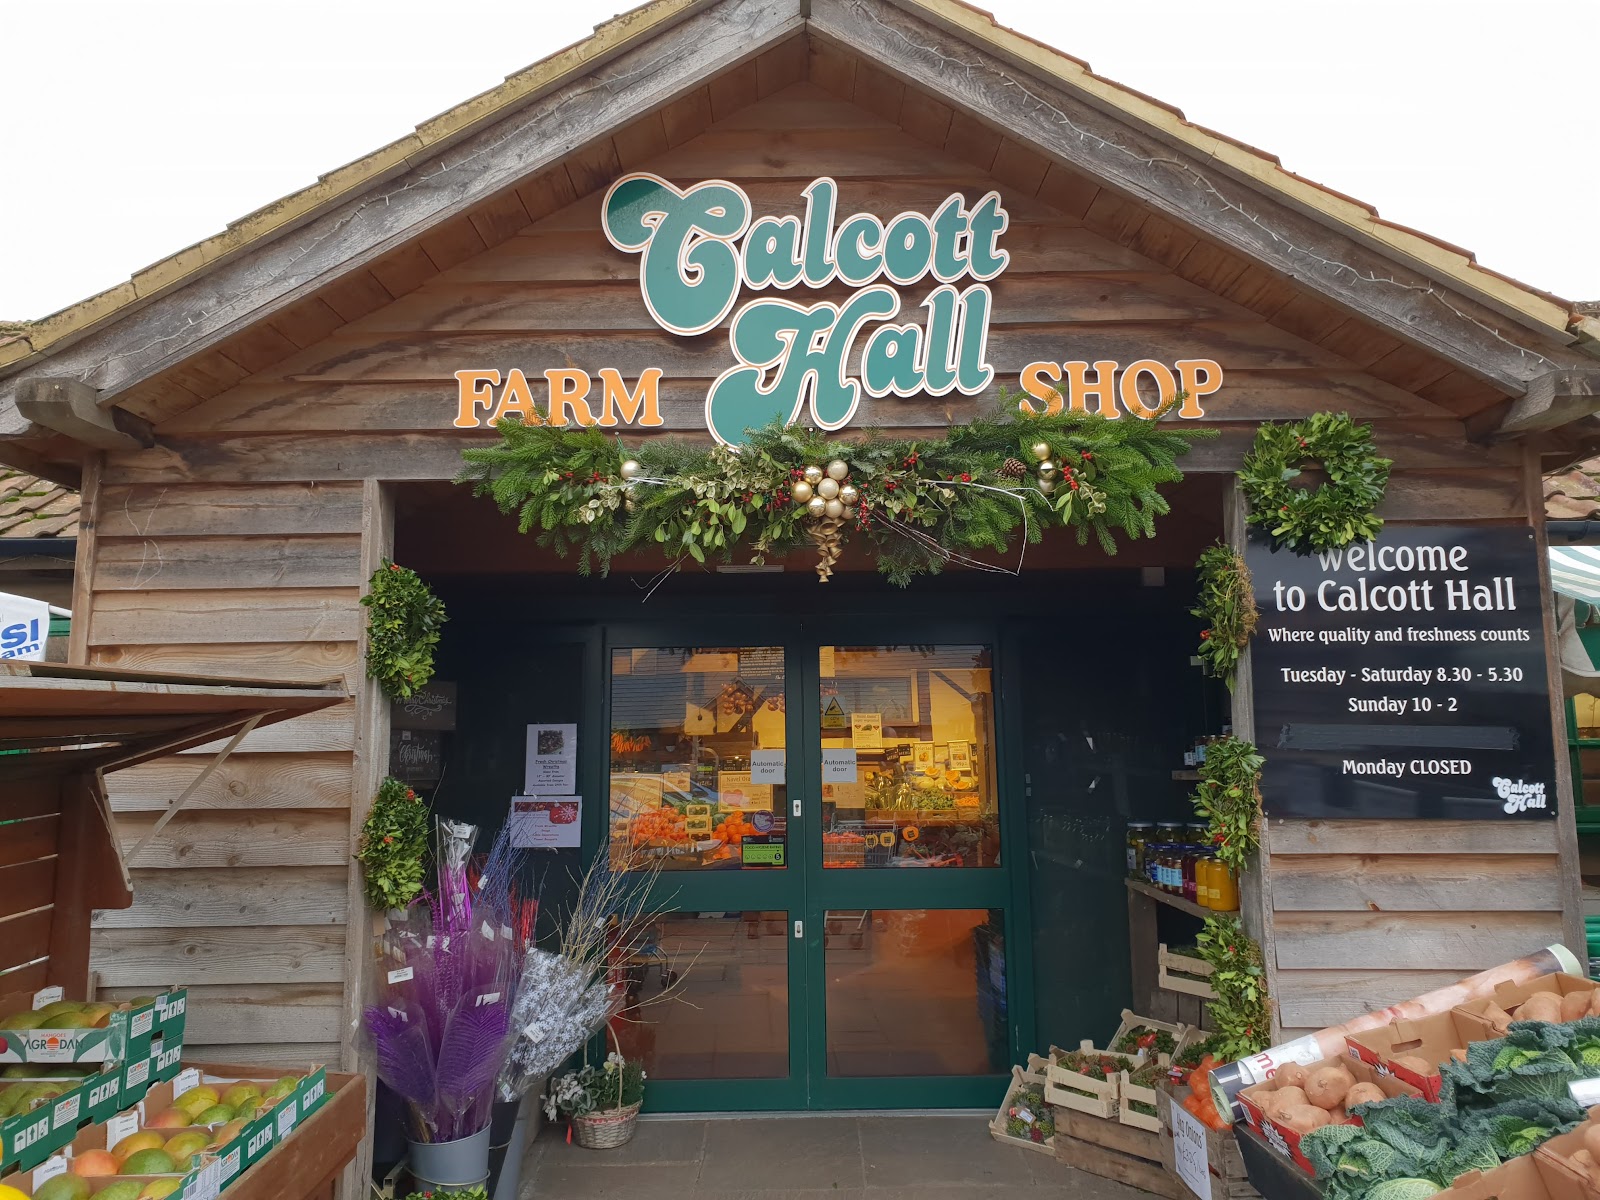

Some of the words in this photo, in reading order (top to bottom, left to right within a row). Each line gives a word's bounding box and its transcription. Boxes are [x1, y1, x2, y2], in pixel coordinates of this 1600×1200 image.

[602, 172, 1009, 336] Calcott
[705, 283, 994, 449] Hall
[454, 367, 664, 429] FARM
[1019, 359, 1223, 420] SHOP
[1273, 580, 1306, 612] to
[1317, 577, 1435, 612] Calcott
[1445, 577, 1517, 611] Hall
[1268, 628, 1315, 642] Where
[1318, 627, 1370, 645] quality
[1374, 627, 1403, 642] and
[1407, 626, 1477, 642] freshness
[1481, 628, 1530, 642] counts
[1281, 667, 1346, 685] Tuesday
[1361, 666, 1432, 685] Saturday
[1437, 667, 1472, 682] 8.30
[1488, 667, 1523, 682] 5.30
[1348, 696, 1407, 715] Sunday
[1412, 697, 1431, 712] 10
[1448, 697, 1458, 712] 2
[1342, 759, 1405, 777] Monday
[1410, 760, 1472, 775] CLOSED
[1492, 776, 1546, 798] Calcott
[1503, 793, 1546, 814] Hall
[25, 1038, 83, 1052] AGRODAN
